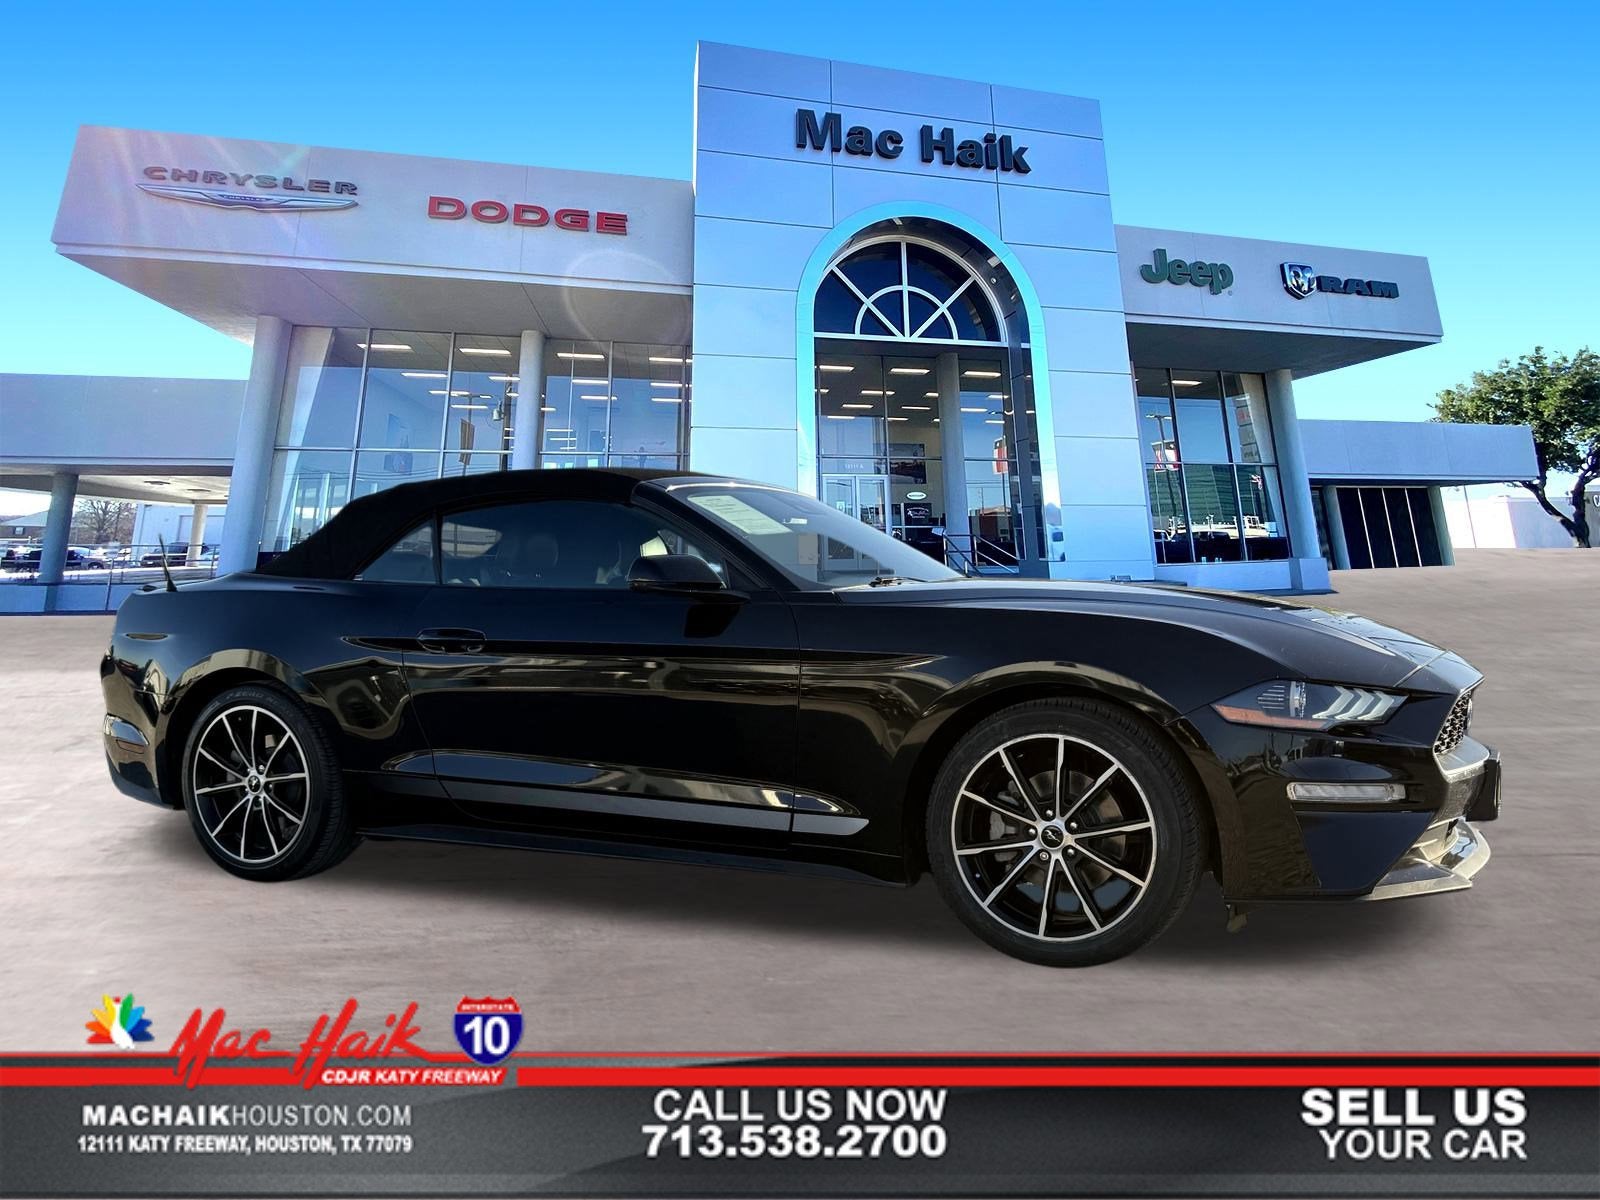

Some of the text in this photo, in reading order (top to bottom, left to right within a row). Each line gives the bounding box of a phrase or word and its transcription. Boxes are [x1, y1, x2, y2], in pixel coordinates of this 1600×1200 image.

[795, 108, 1032, 174] Mac Haik
[142, 165, 358, 196] CHRYSLER
[428, 196, 628, 236] DODGE
[1140, 248, 1234, 295] Jeep
[1316, 275, 1399, 298] RAM
